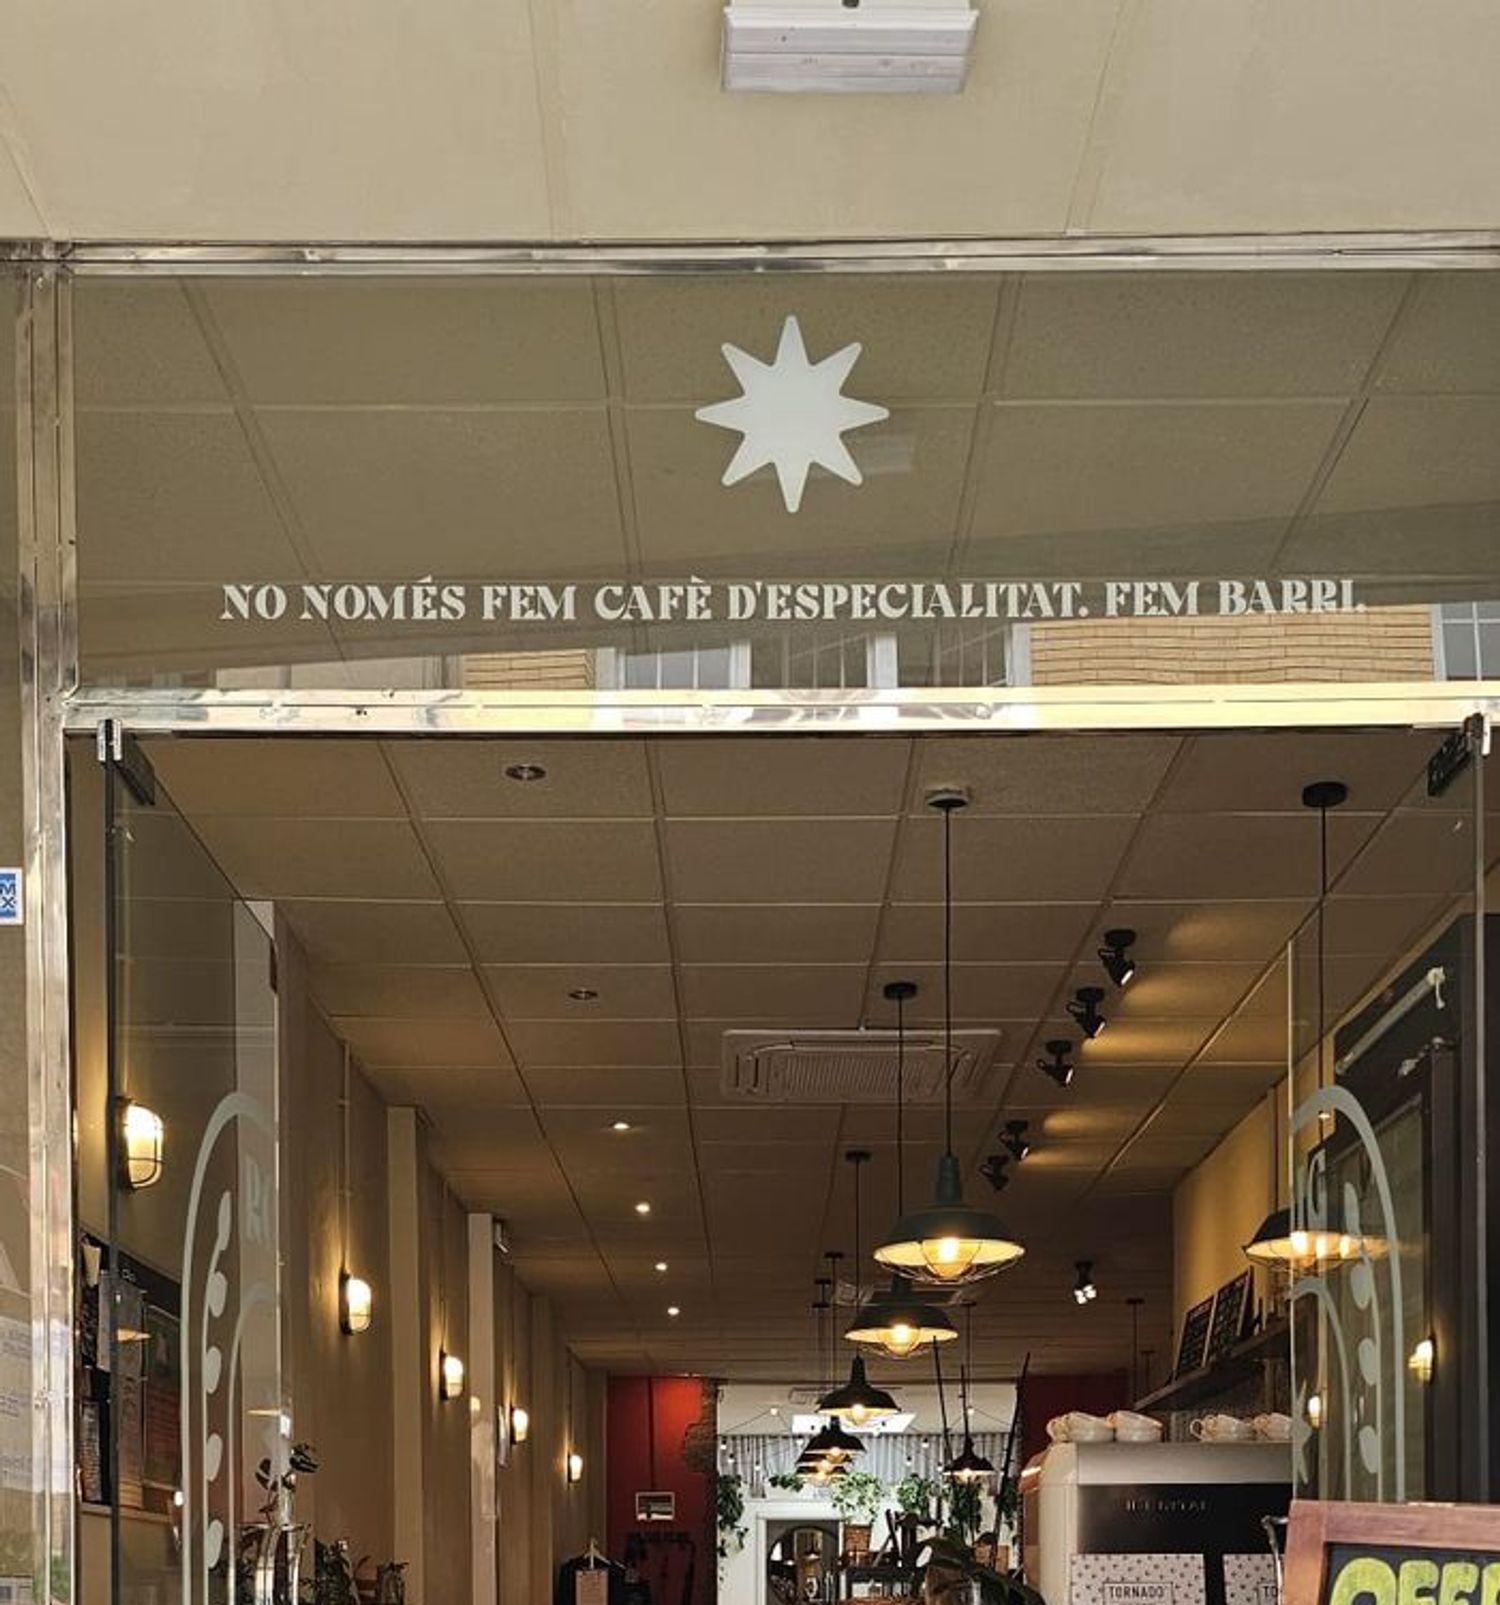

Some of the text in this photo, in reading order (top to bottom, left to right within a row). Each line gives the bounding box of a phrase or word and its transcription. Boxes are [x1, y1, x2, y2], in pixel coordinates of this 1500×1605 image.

[219, 574, 1368, 620] NO NOMÉS FEM CAFÈ D'ESPECIALITAT. FEM BARRI.
[1108, 1585, 1166, 1599] TORNADO
